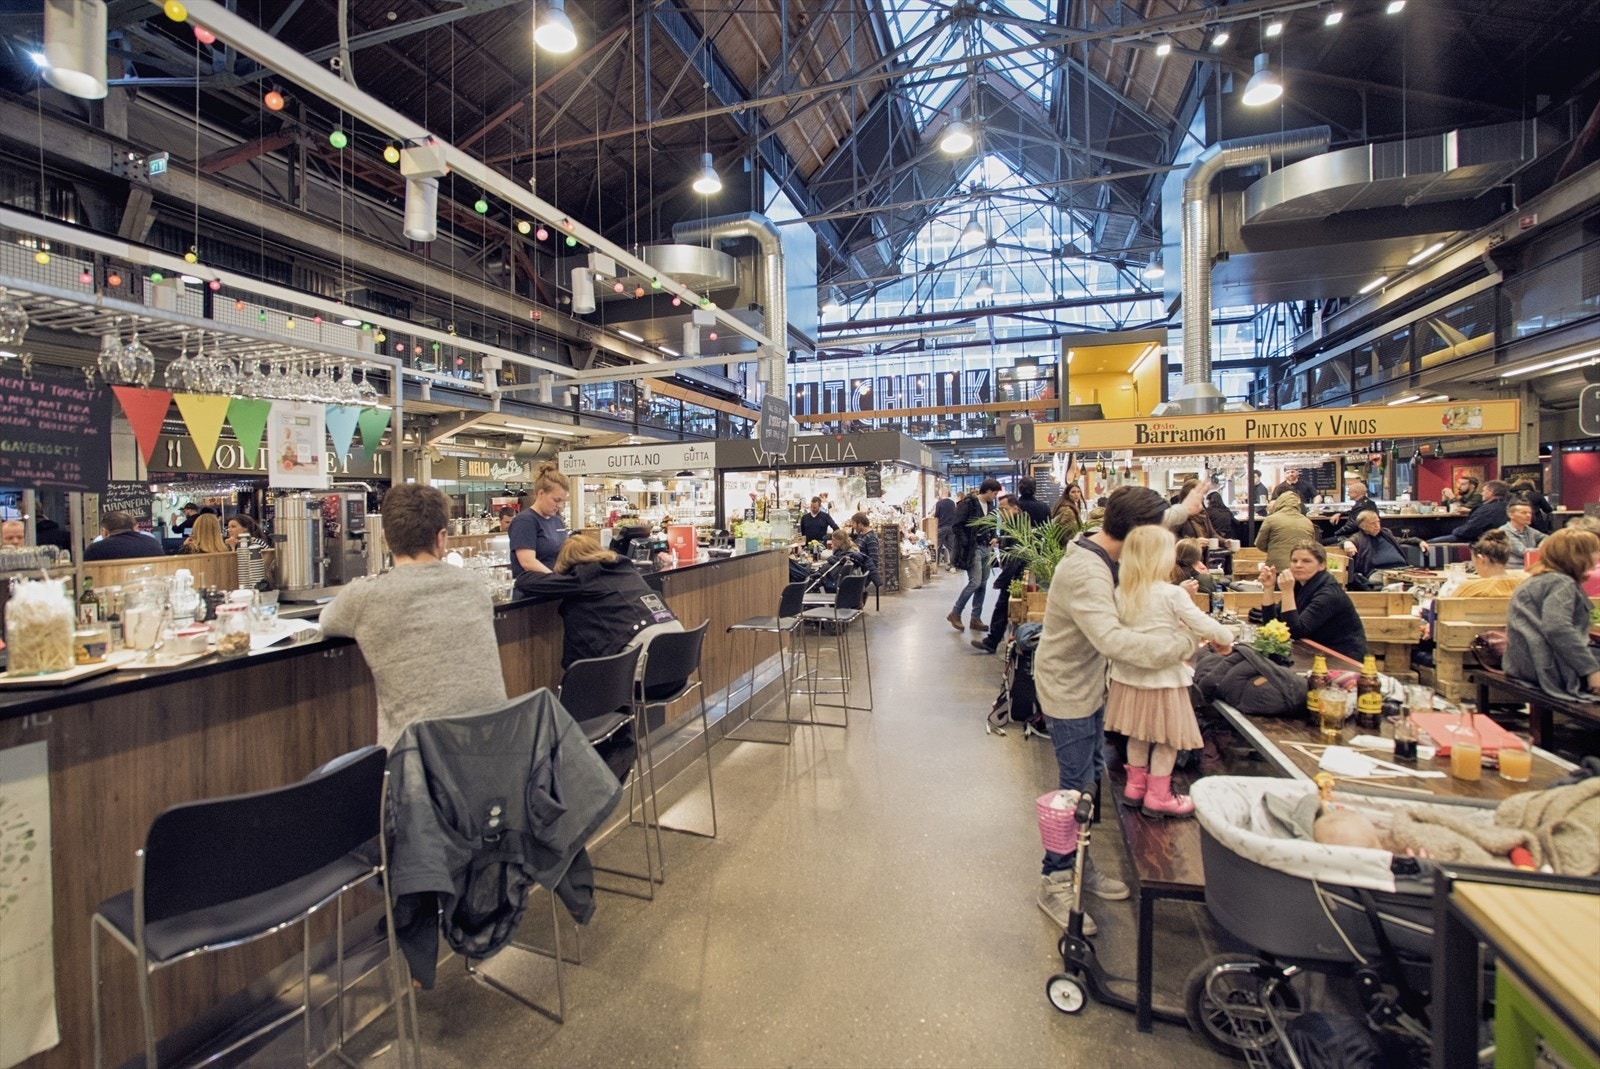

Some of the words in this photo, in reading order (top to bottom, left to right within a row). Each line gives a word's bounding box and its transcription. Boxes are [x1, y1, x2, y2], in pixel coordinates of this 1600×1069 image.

[1134, 423, 1226, 444] Barramón
[563, 458, 586, 469] GUTTA
[607, 453, 660, 467] GUTTA.NO
[683, 451, 709, 462] GUTTA
[468, 461, 490, 477] HELLO
